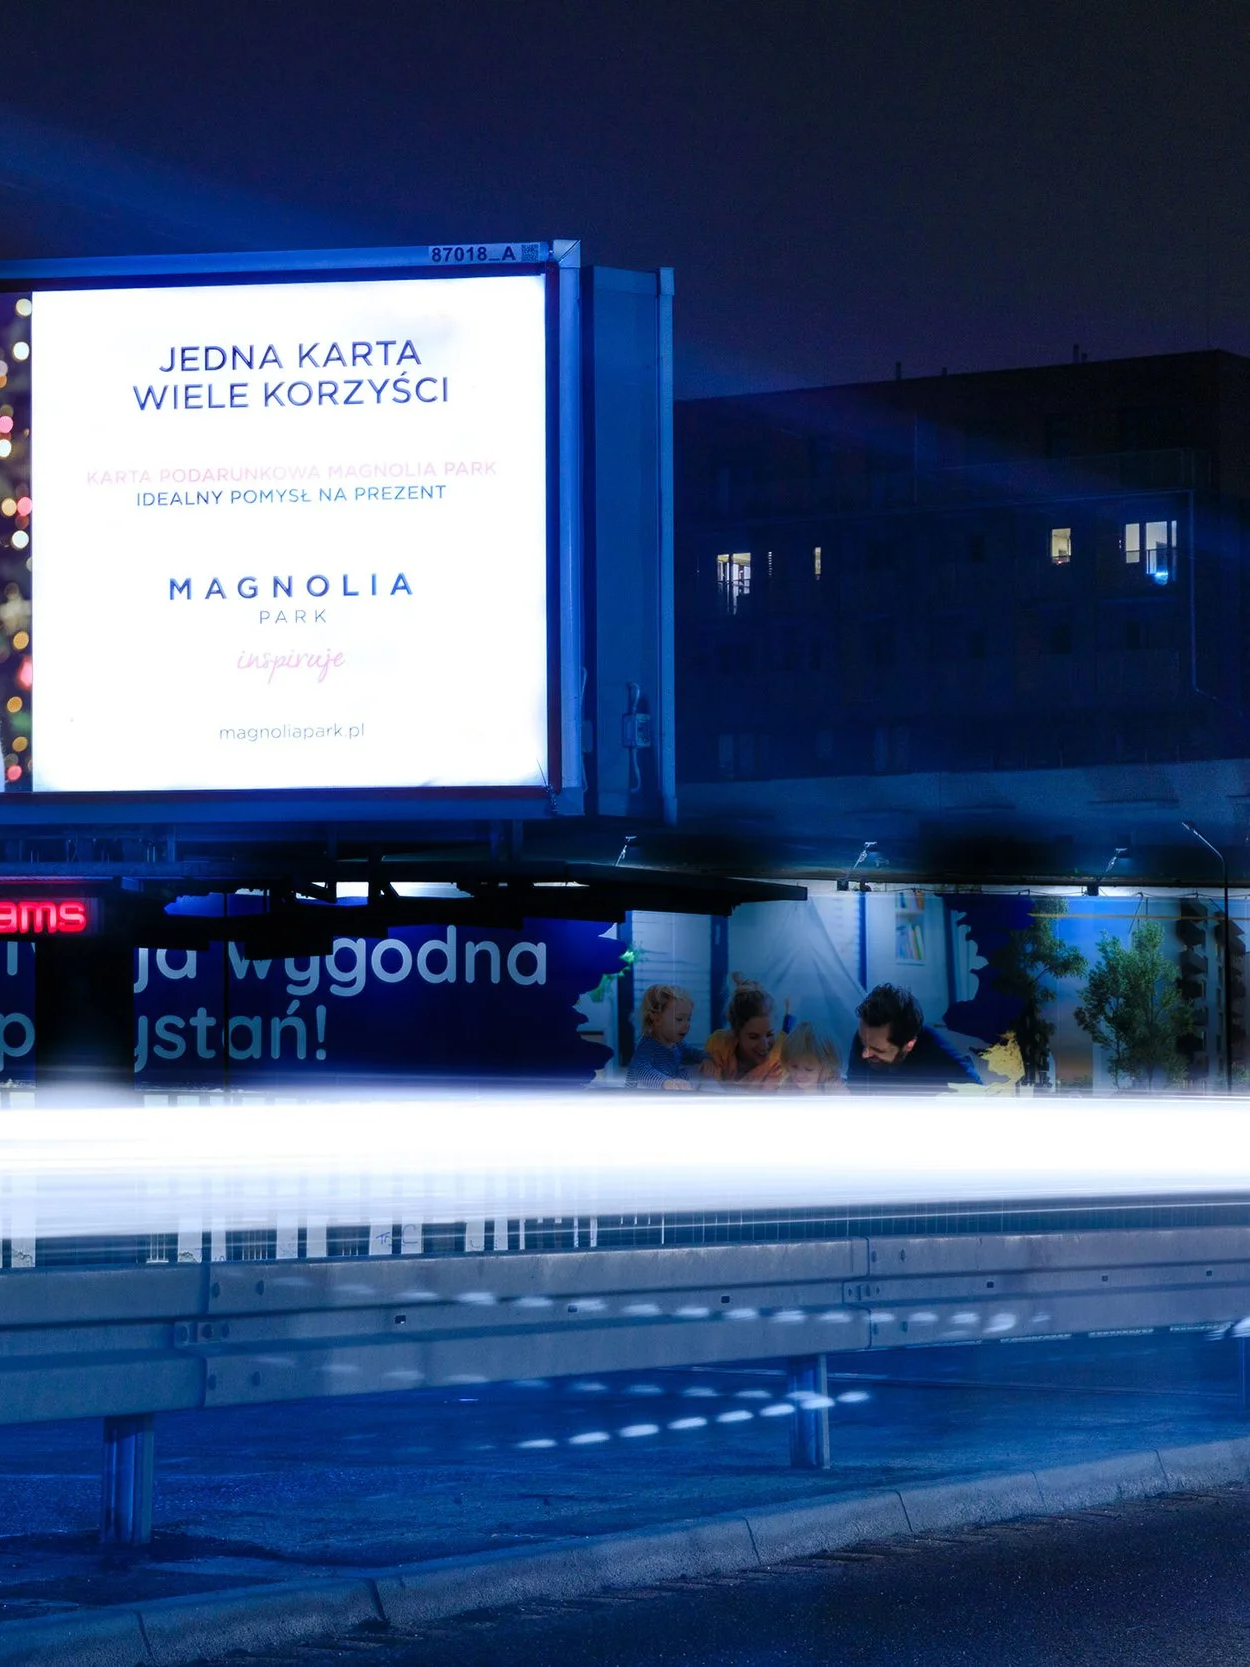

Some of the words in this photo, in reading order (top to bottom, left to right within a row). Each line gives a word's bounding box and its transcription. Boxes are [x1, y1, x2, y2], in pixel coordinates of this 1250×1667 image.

[431, 246, 516, 262] 87018_A
[158, 343, 284, 373] JEDNA
[298, 339, 422, 368] KARTA
[132, 382, 250, 411] WIELE
[263, 372, 448, 407] KORZYŚCI
[86, 469, 152, 485] KARTA
[159, 465, 321, 484] PODARUNKOWA
[328, 462, 438, 480] MAGNOLIA
[444, 460, 497, 476] PARK
[136, 490, 223, 507] IDEALNY
[230, 488, 311, 505] POMYSŁ
[318, 487, 348, 503] NA
[354, 484, 447, 501] PREZENT
[169, 572, 414, 601] MAGNOLIA
[259, 609, 327, 625] PARK
[237, 648, 346, 684] inspiruje
[219, 722, 365, 742] magnoliapark.pl
